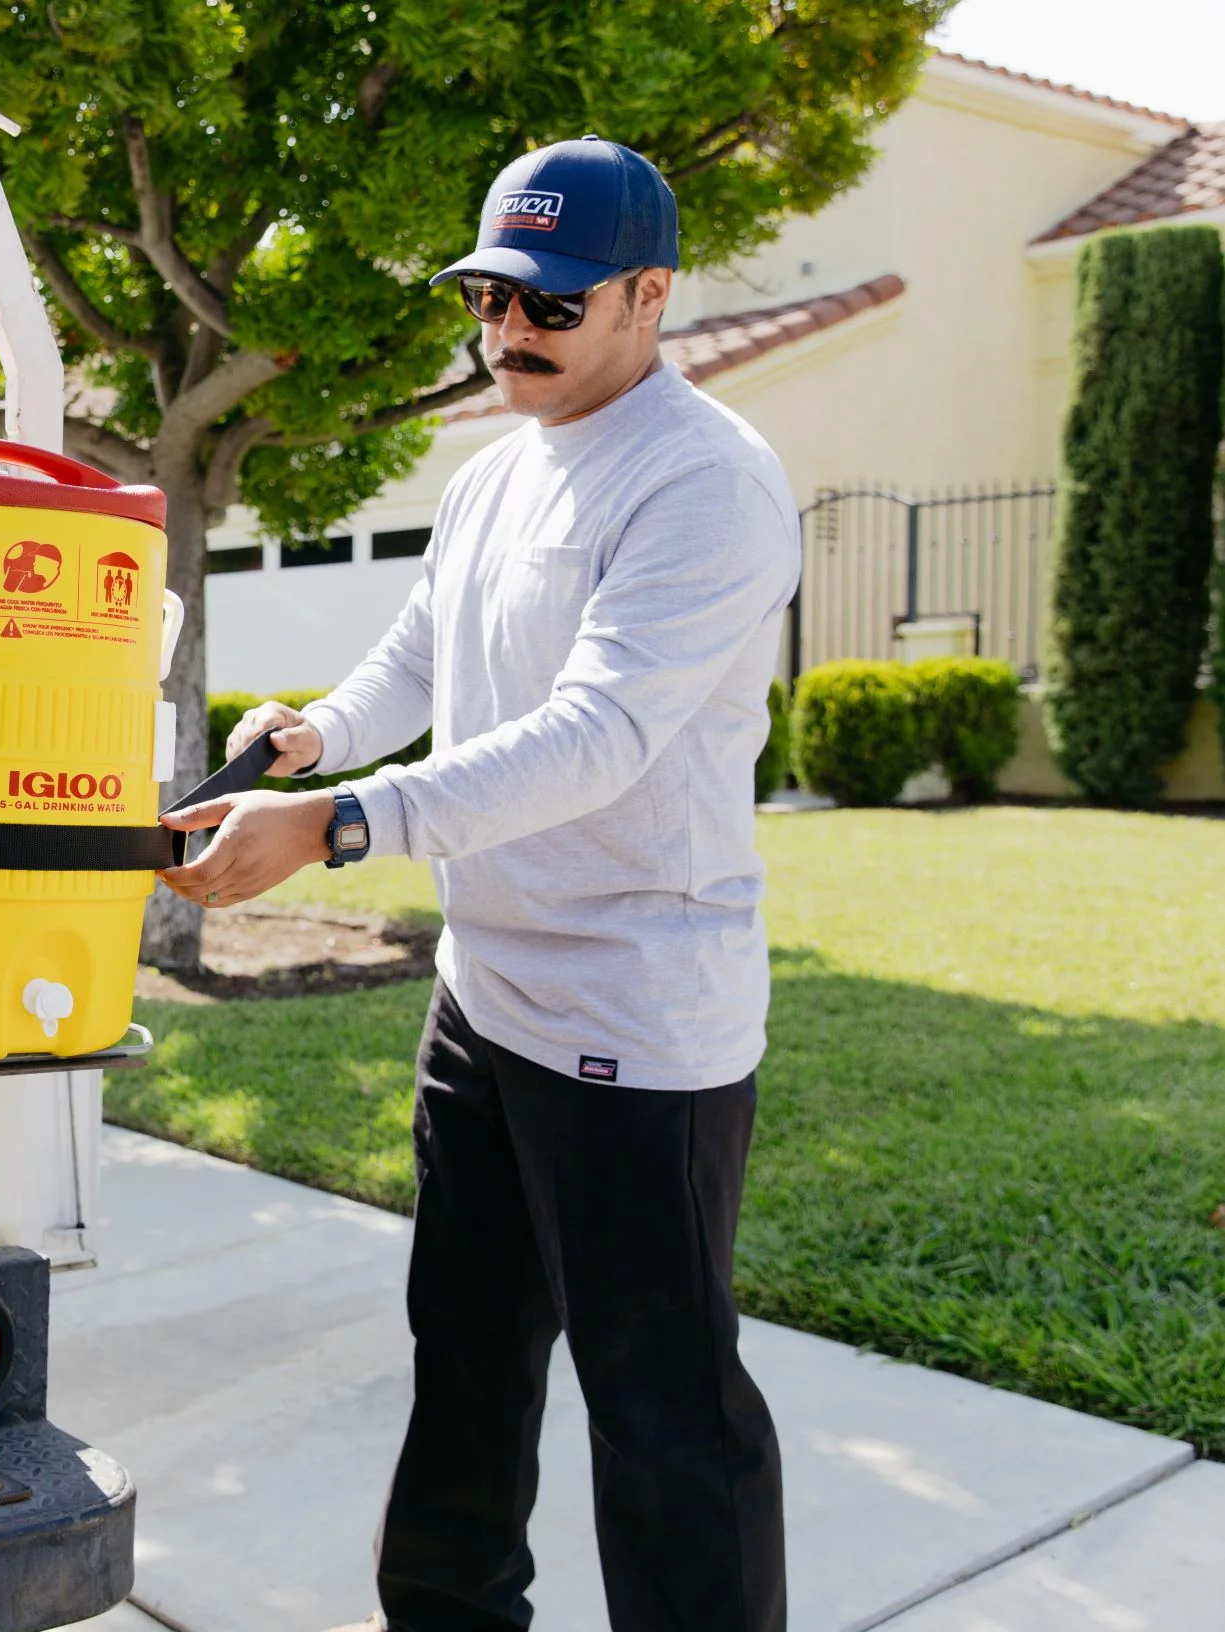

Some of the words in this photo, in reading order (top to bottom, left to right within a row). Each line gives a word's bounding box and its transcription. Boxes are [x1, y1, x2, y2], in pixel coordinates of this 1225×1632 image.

[8, 770, 122, 800] IGLOO
[0, 800, 39, 810] 5-GAL
[42, 801, 95, 812] DRINKING
[97, 803, 126, 813] WATER
